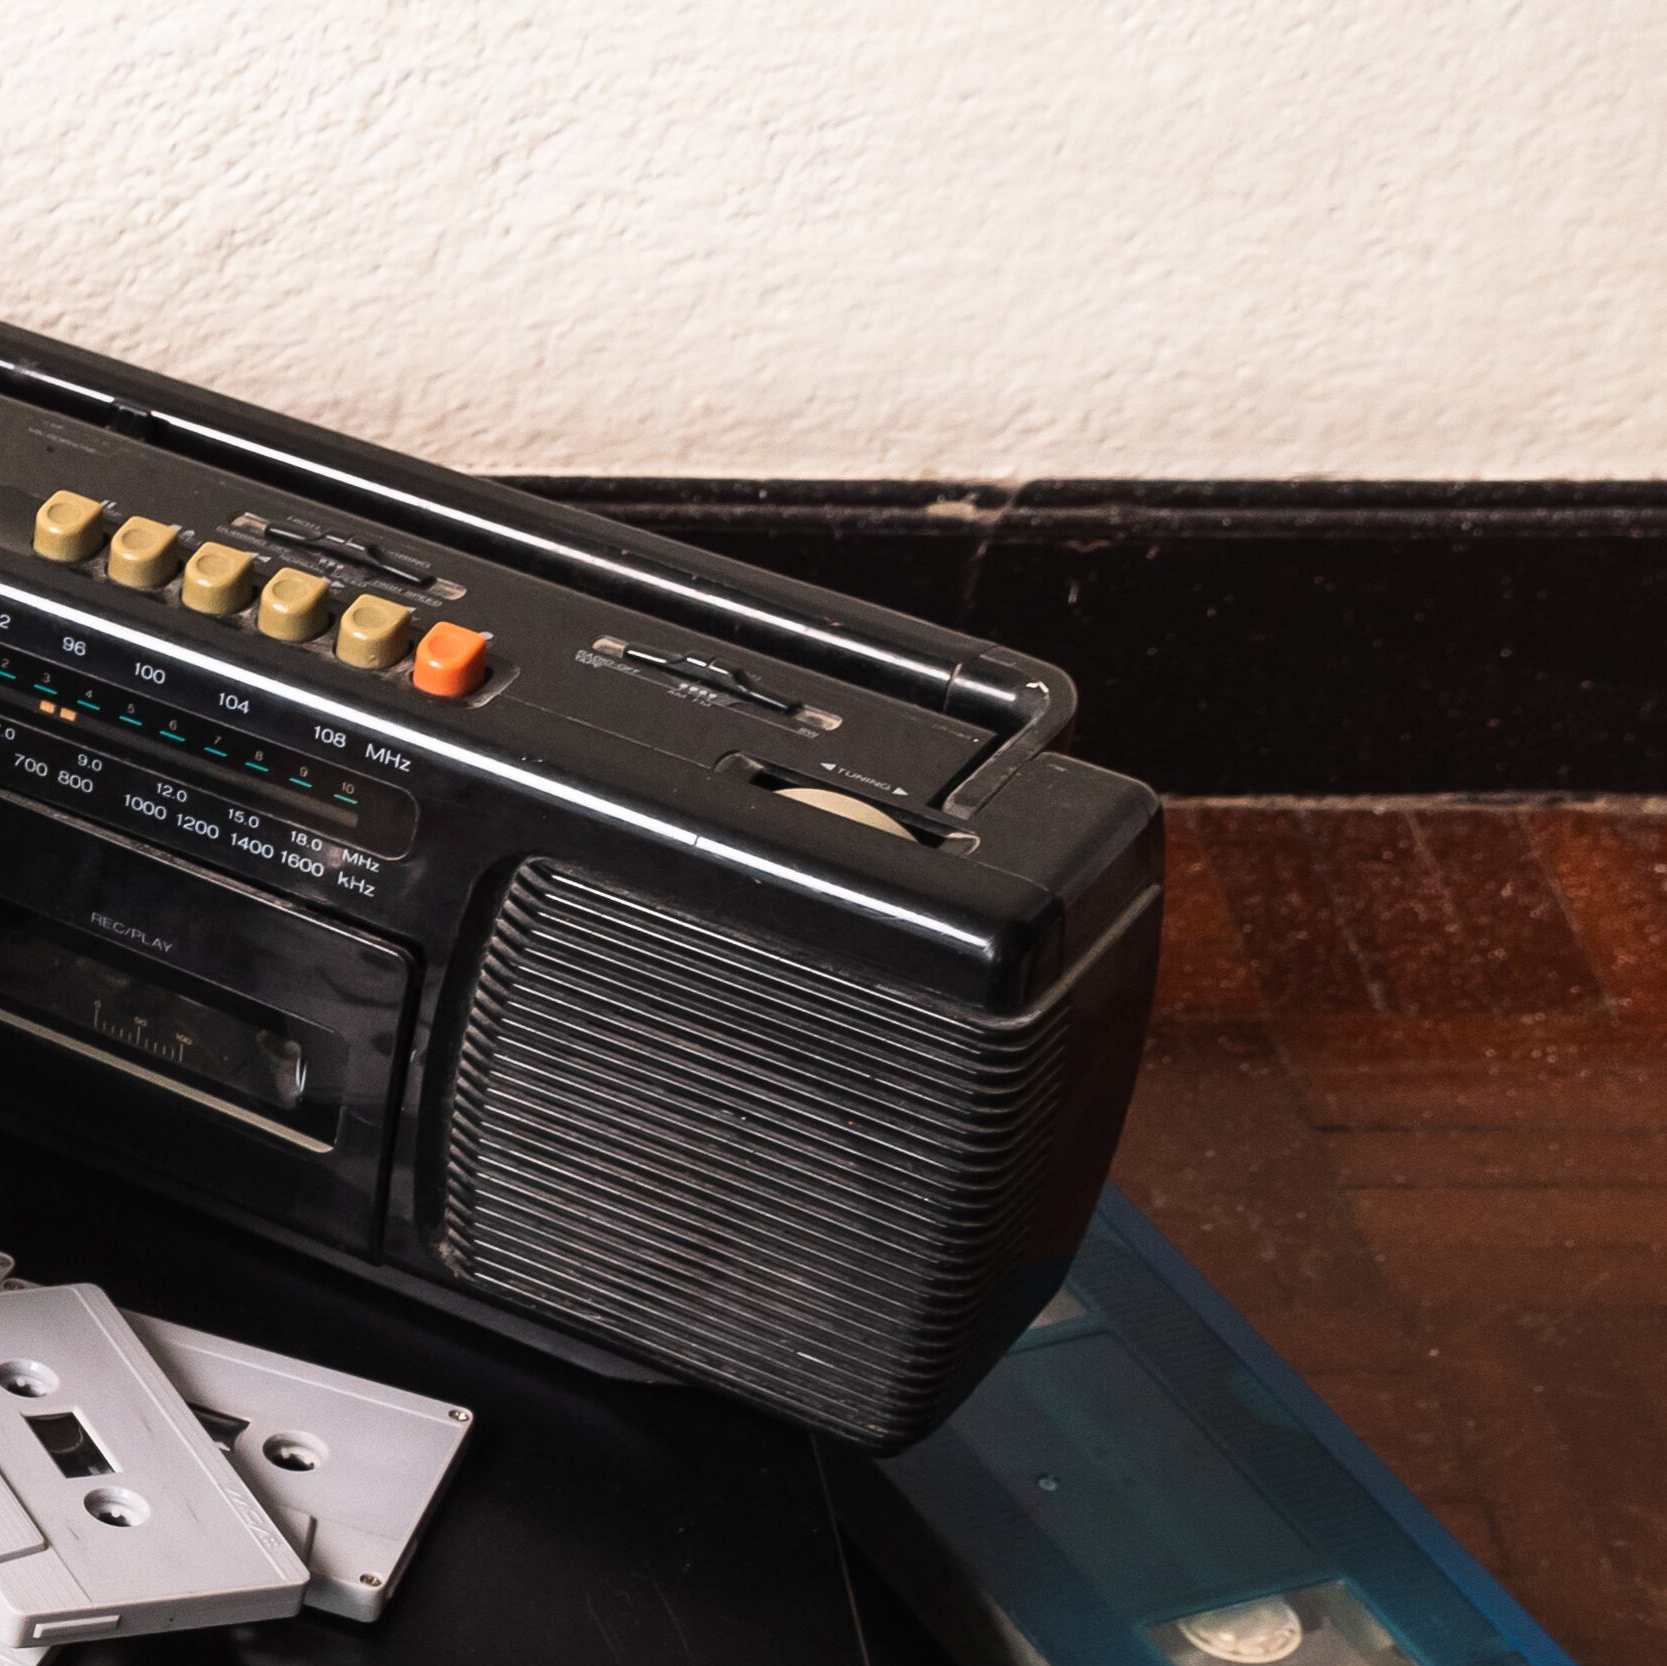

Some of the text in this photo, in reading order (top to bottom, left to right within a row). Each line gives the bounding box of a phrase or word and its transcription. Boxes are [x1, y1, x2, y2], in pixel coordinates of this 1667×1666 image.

[0, 658, 10, 668] 2
[42, 673, 51, 683] 3
[85, 689, 93, 699] 4
[126, 703, 135, 714] 5
[168, 720, 178, 731] 6
[213, 735, 222, 745] 7
[254, 751, 264, 761] 8
[299, 766, 309, 778] 9
[341, 782, 355, 794] 10
[62, 636, 86, 656] 96
[134, 663, 166, 684] 100
[218, 693, 250, 715] 104
[314, 726, 347, 748] 108
[366, 743, 411, 772] MHz
[13, 754, 48, 777] 700
[57, 769, 93, 793] 800
[124, 793, 167, 821] 1000
[176, 813, 219, 839] 1200
[230, 832, 274, 859] 1400
[280, 850, 324, 877] 1600
[338, 872, 375, 897] kHz
[78, 754, 102, 772] 9.0
[156, 782, 187, 802] 12.0
[228, 808, 259, 829] 15.0
[290, 830, 322, 851] 18.0
[342, 849, 380, 873] MHz
[838, 767, 891, 791] TUNING
[91, 912, 174, 950] REC/PLAY
